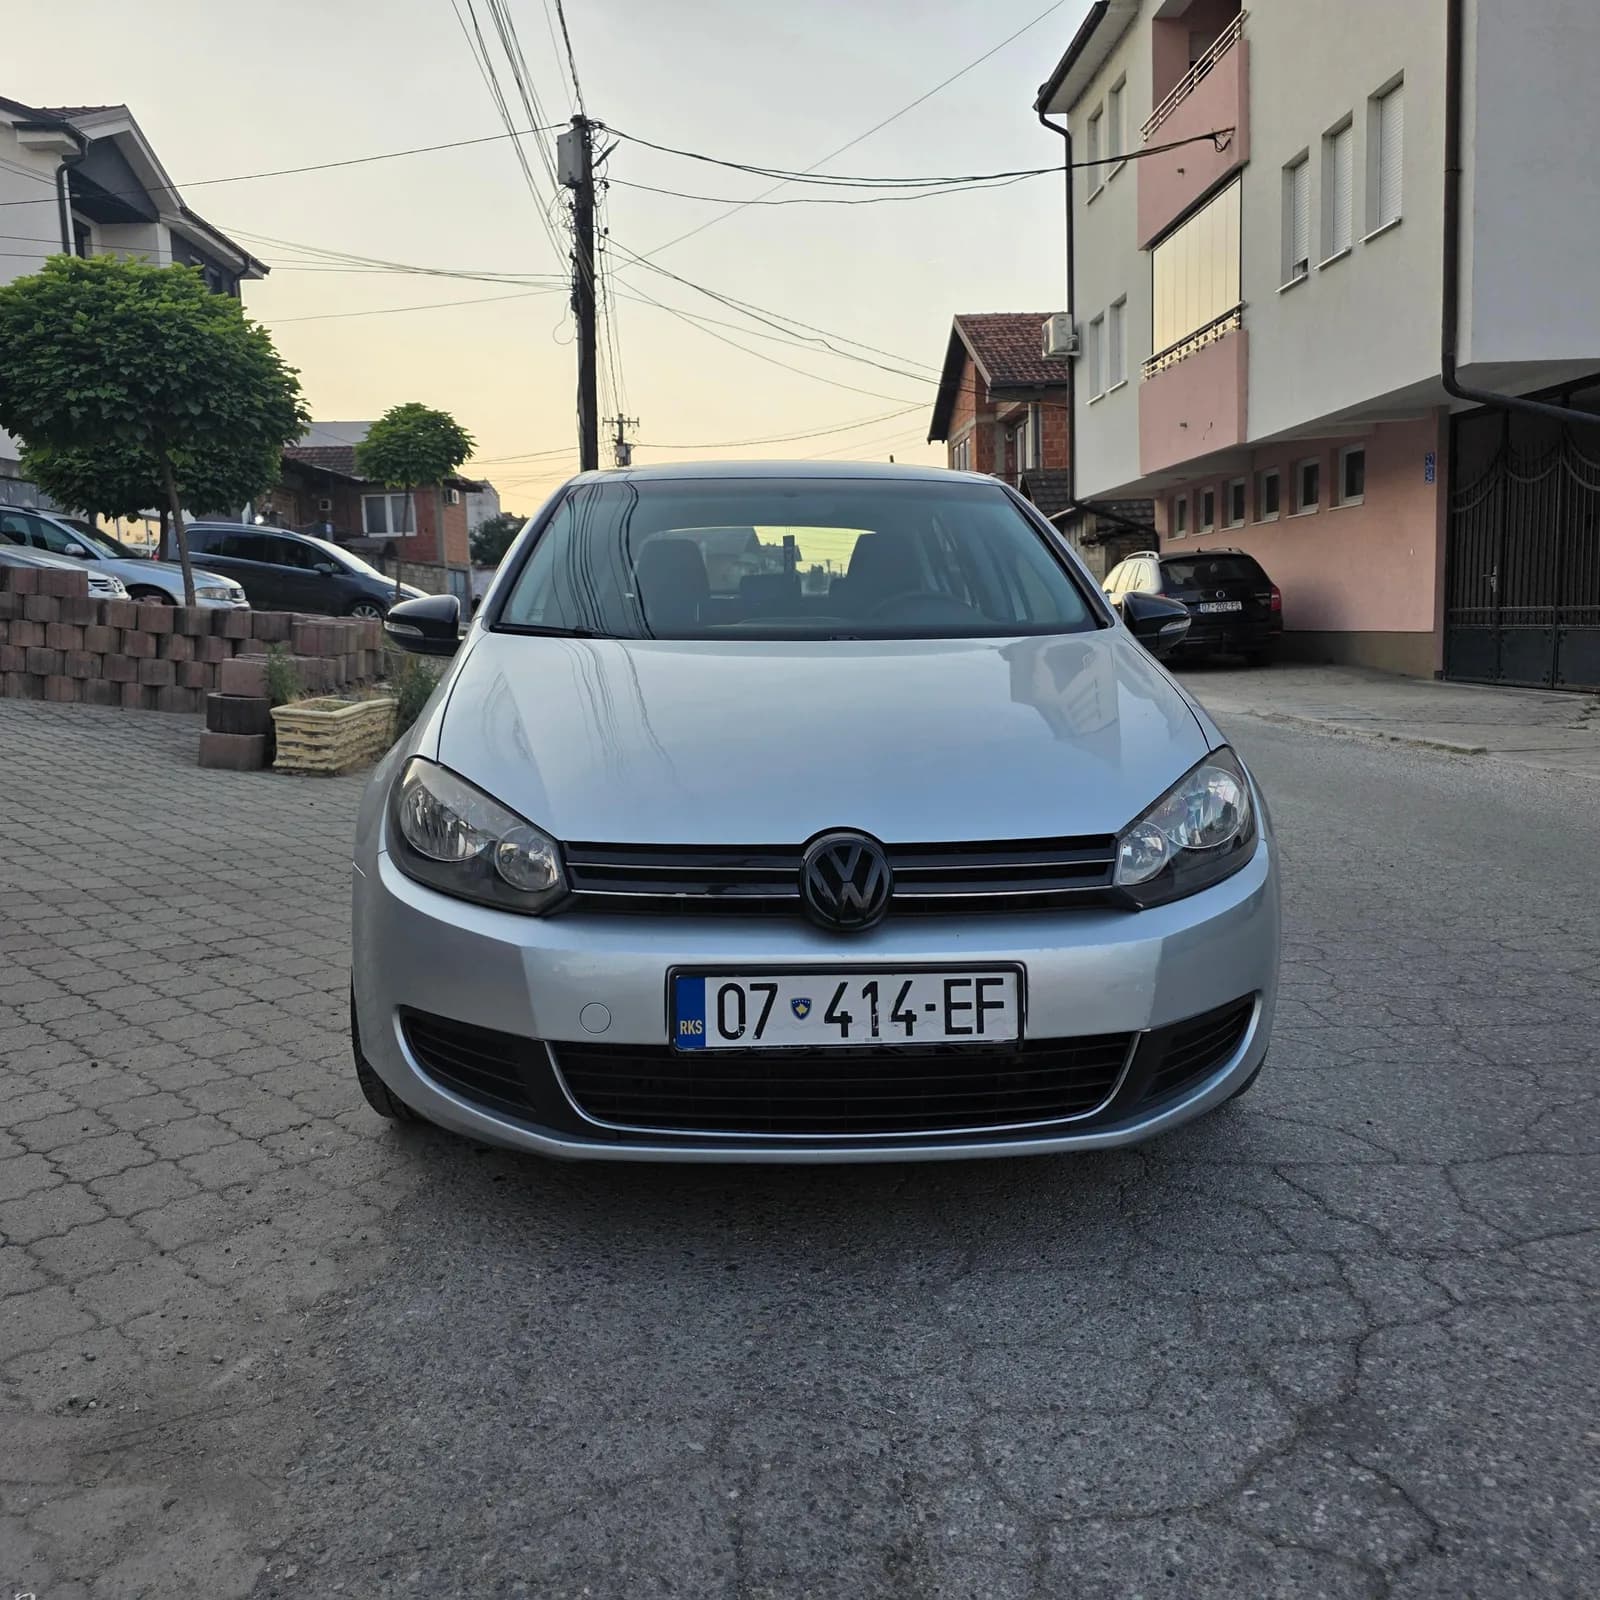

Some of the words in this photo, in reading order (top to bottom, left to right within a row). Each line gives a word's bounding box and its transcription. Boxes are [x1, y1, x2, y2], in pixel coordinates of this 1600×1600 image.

[808, 842, 886, 922] VW
[680, 1021, 703, 1036] RKS
[717, 982, 779, 1041] 07
[823, 977, 1006, 1038] 414-EF
